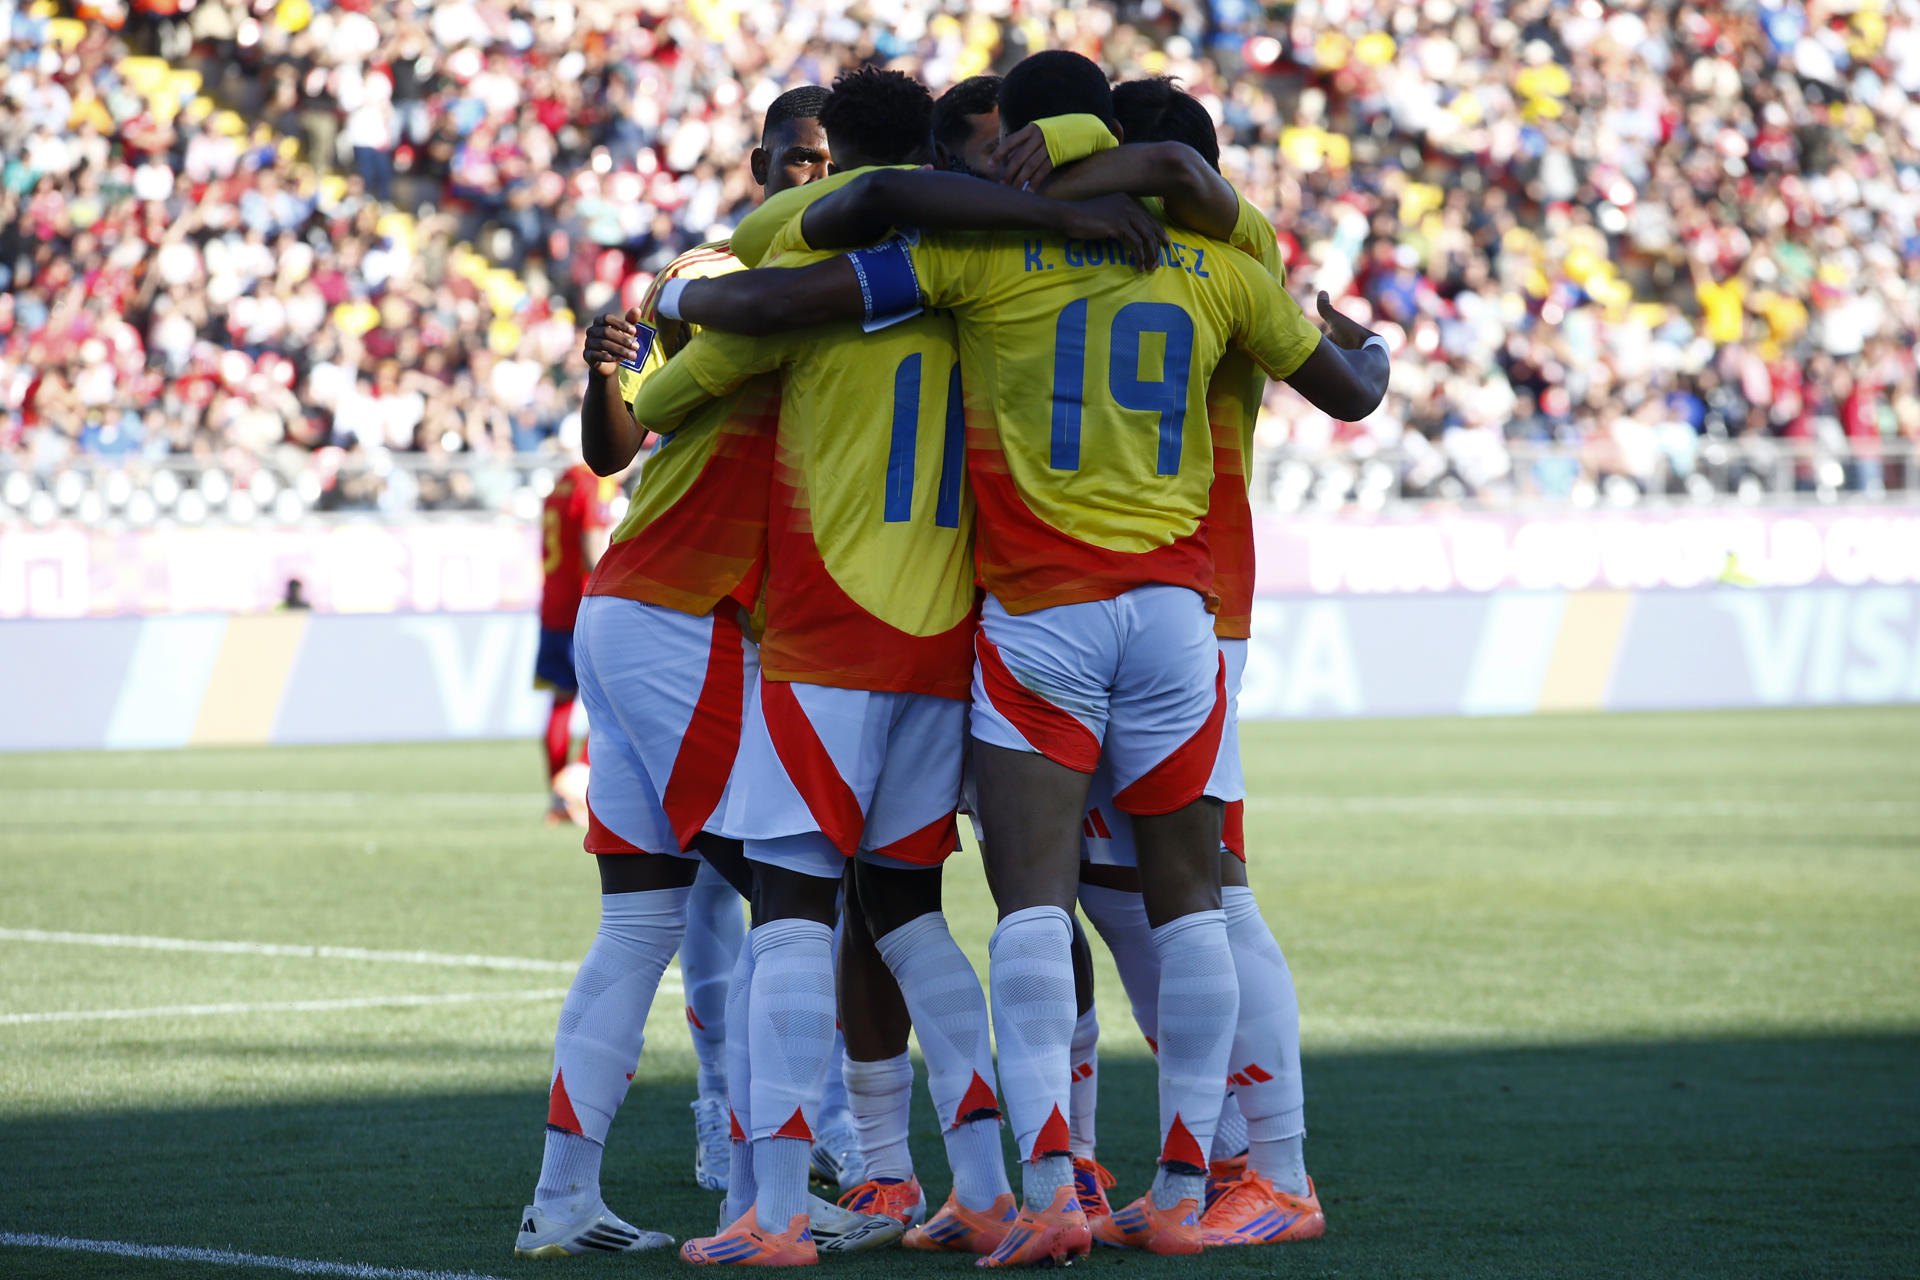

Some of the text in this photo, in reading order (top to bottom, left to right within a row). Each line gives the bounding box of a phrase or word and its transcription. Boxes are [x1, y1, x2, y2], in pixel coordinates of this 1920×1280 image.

[1024, 238, 1209, 278] K. GONLEZ
[884, 352, 964, 528] 11
[1049, 298, 1194, 476] 19
[1717, 588, 1920, 705] VIS
